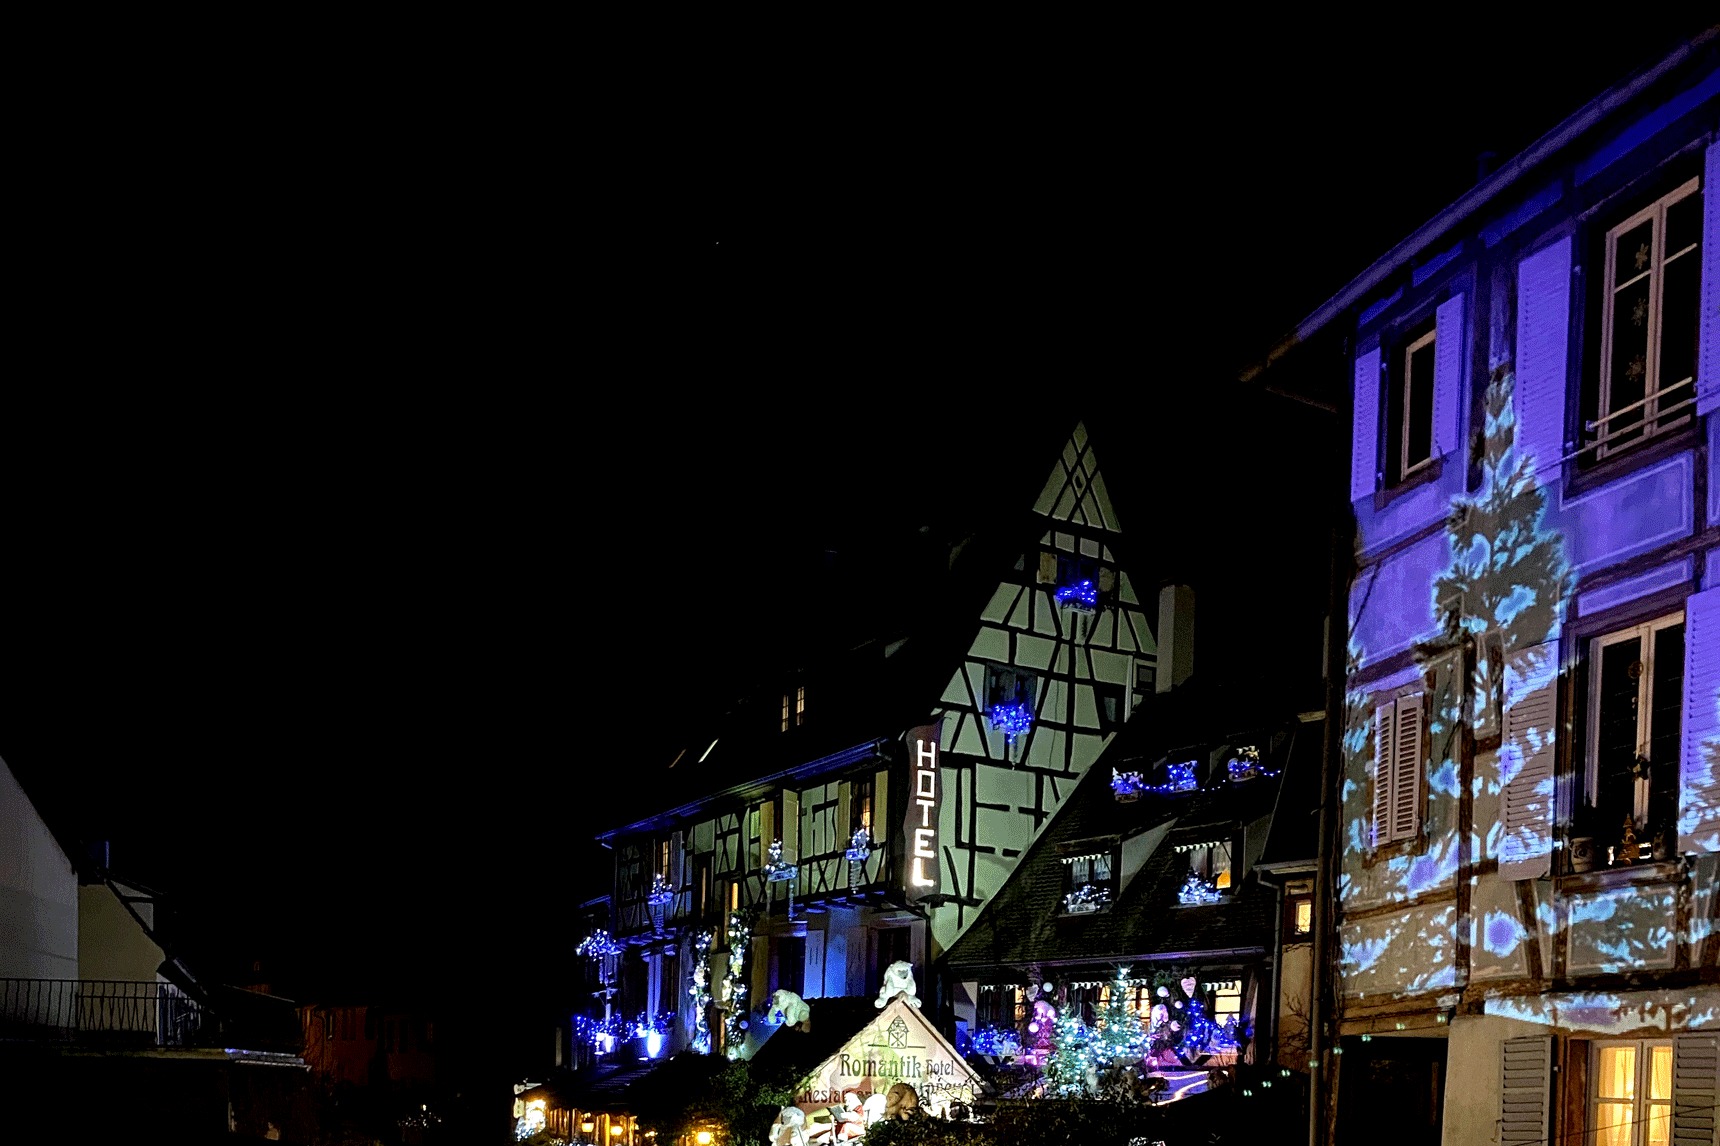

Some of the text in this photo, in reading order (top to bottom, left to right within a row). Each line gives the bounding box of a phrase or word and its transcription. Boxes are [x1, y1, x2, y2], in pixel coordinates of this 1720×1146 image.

[912, 739, 936, 887] HOTEL
[840, 1053, 922, 1078] Romantik
[799, 1088, 877, 1104] Restauan
